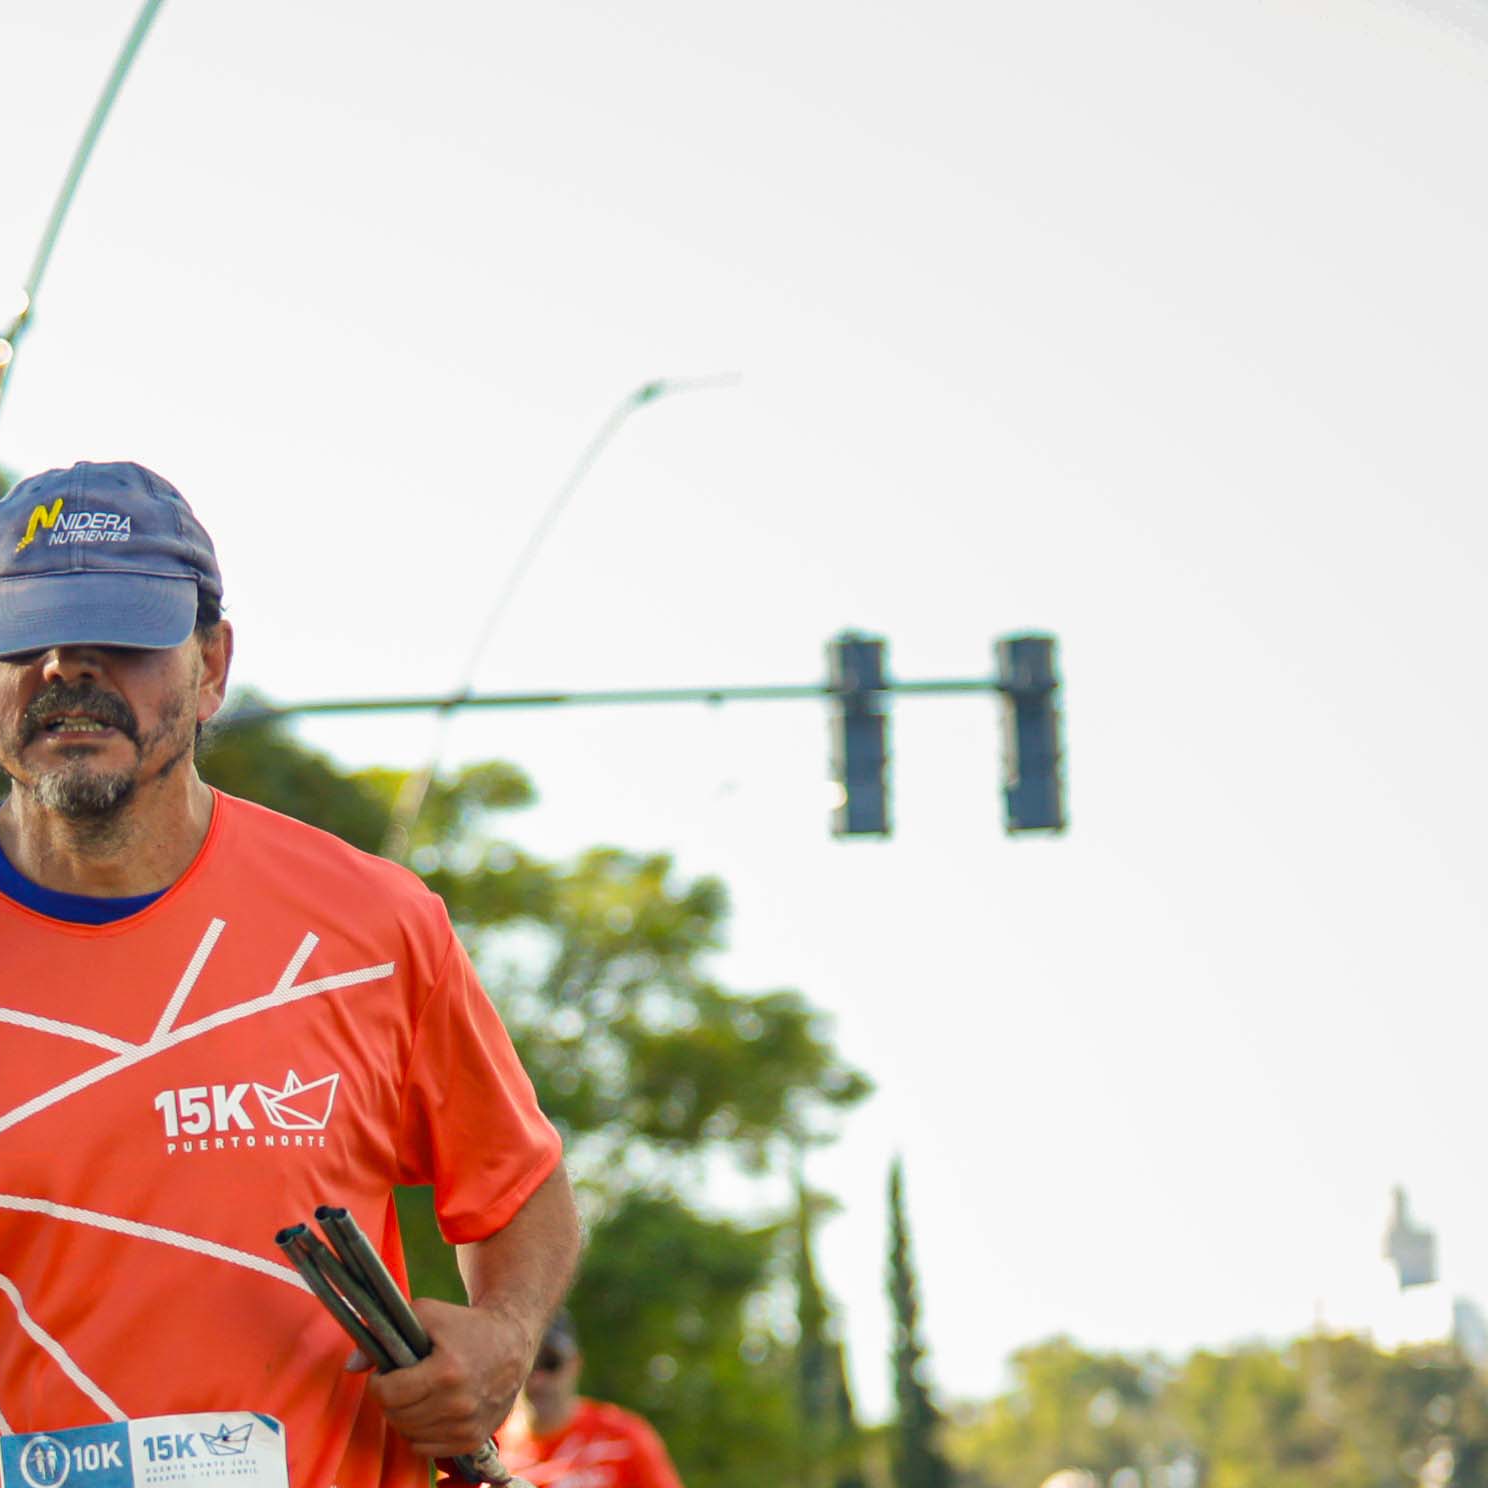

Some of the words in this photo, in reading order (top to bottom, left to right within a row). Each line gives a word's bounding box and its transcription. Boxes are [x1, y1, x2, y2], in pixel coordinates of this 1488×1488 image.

[53, 512, 131, 533] NIDERA
[49, 530, 130, 546] NUTRIENTES
[154, 1083, 255, 1137] 15K
[167, 1136, 256, 1155] PUERTO
[265, 1135, 326, 1148] NORTE
[73, 1441, 123, 1473] 10K
[143, 1433, 198, 1462] 15K
